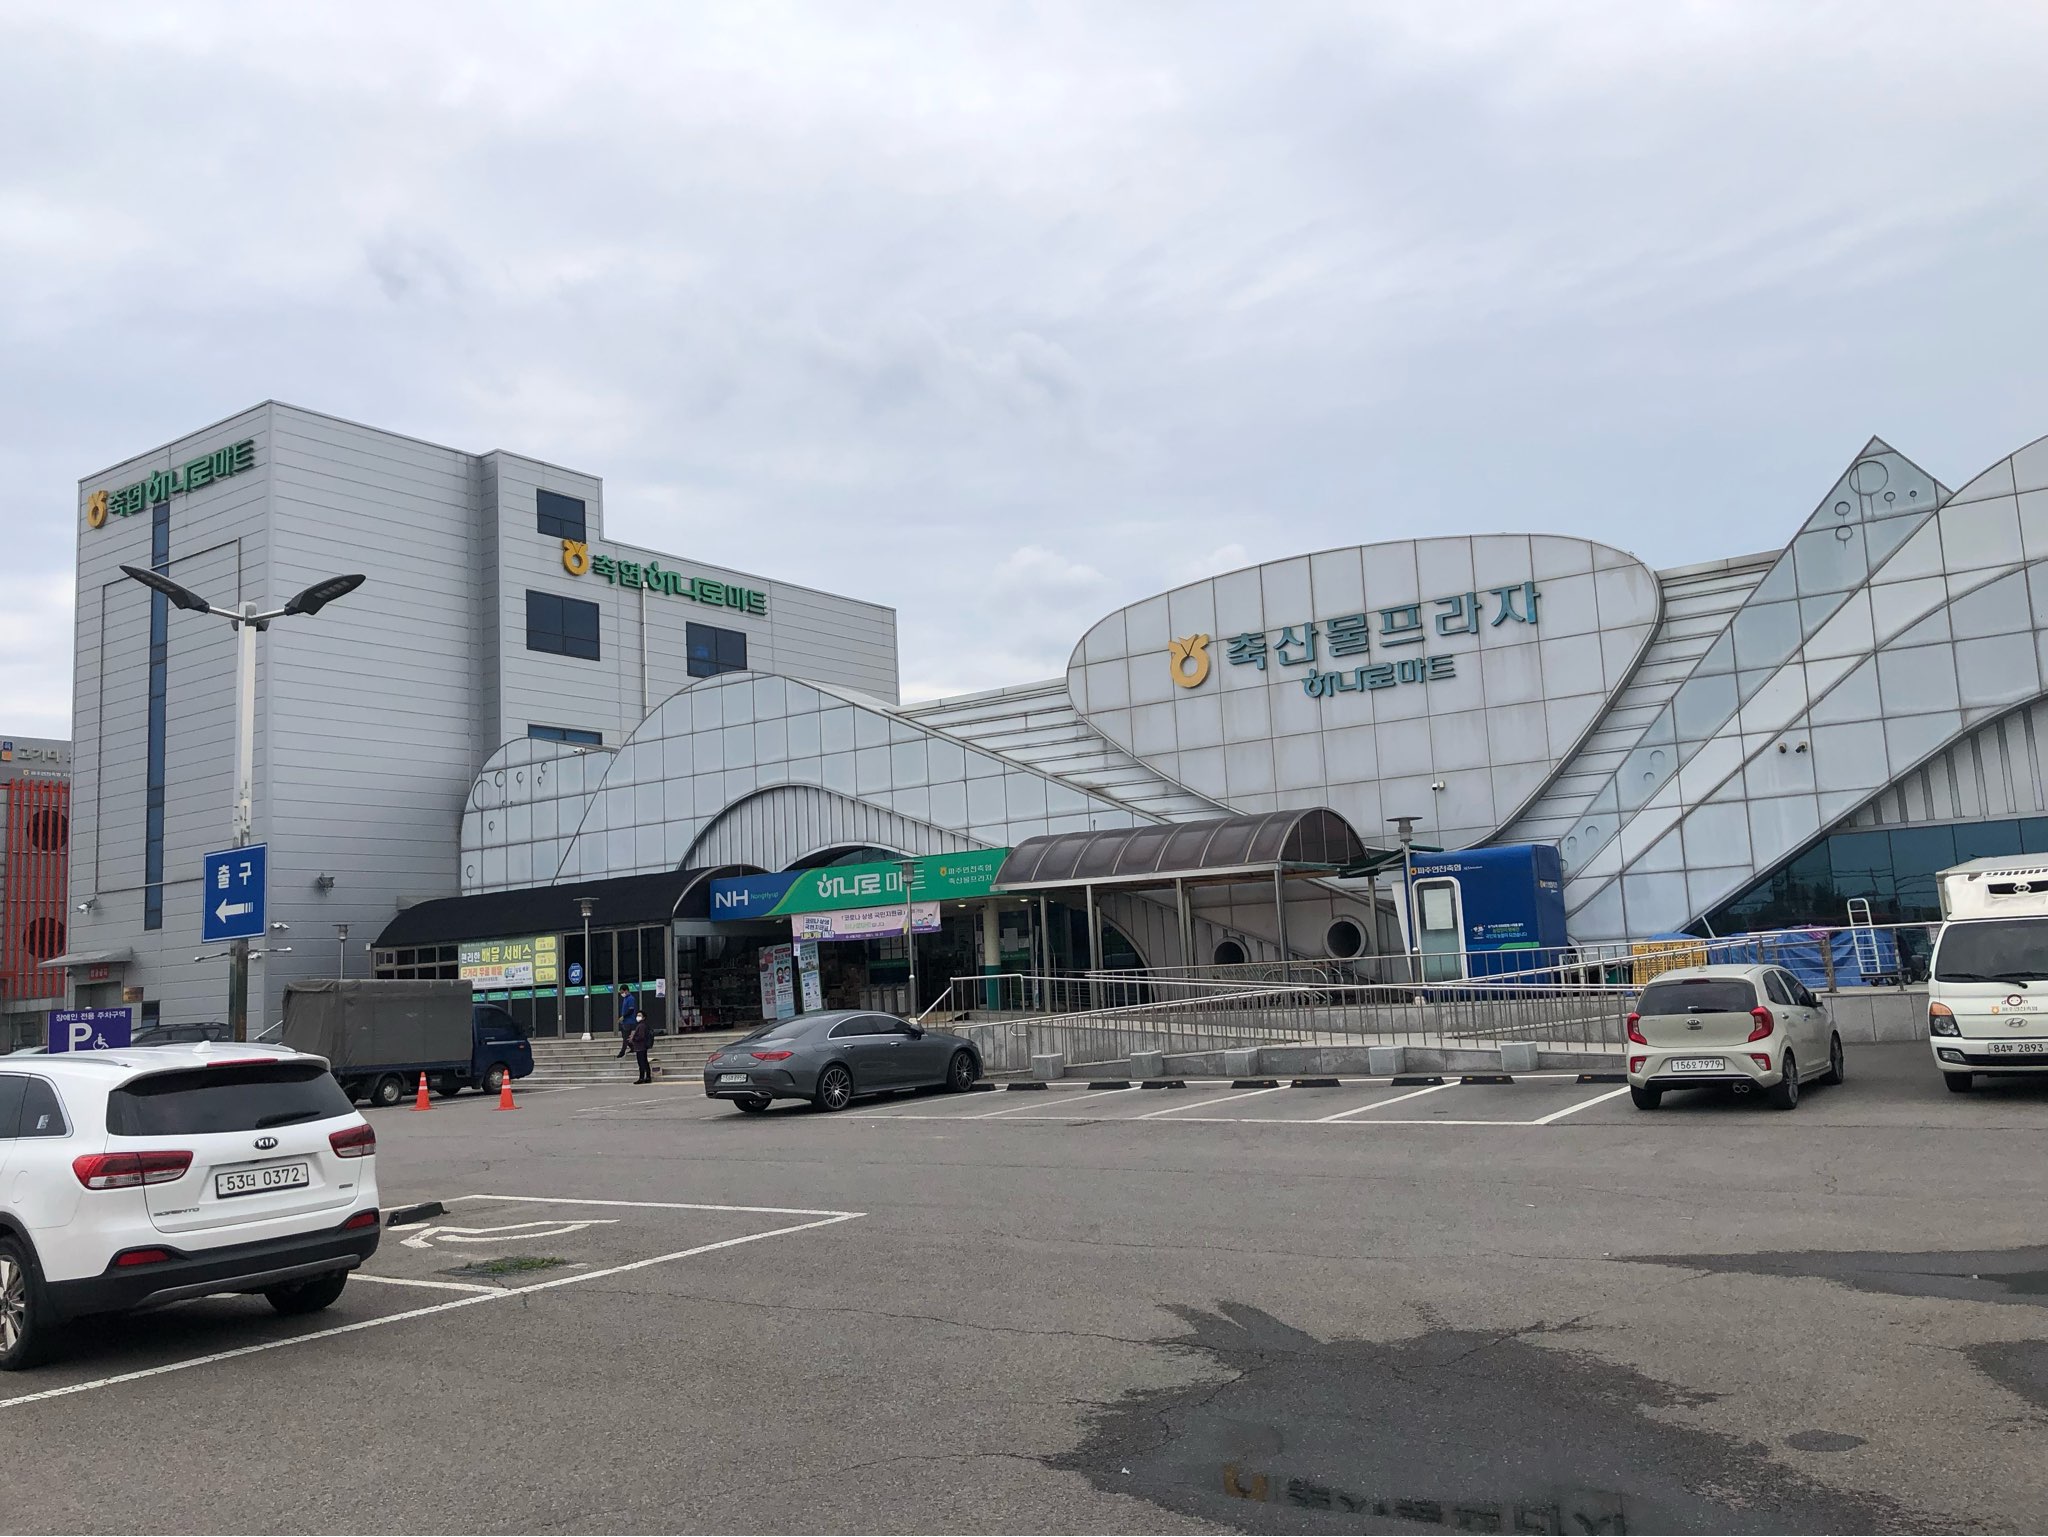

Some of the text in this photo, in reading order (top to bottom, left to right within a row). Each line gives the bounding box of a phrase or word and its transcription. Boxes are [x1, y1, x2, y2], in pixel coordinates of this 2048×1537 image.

[107, 439, 255, 517] 축협 하나로마트
[592, 554, 769, 616] 축협 하나로마트
[1226, 580, 1541, 670] 축산물프라자
[1301, 654, 1456, 698] 하나로마트
[715, 889, 749, 909] NH
[481, 946, 500, 963] 배달
[503, 943, 532, 961] 서비스
[56, 1010, 126, 1022] 장애인 전용 주차구역
[69, 1022, 93, 1051] P
[2018, 1044, 2044, 1053] 2893
[1699, 1059, 1721, 1068] 7979
[257, 1138, 275, 1148] KIA
[227, 1167, 300, 1191] 53더 0372
